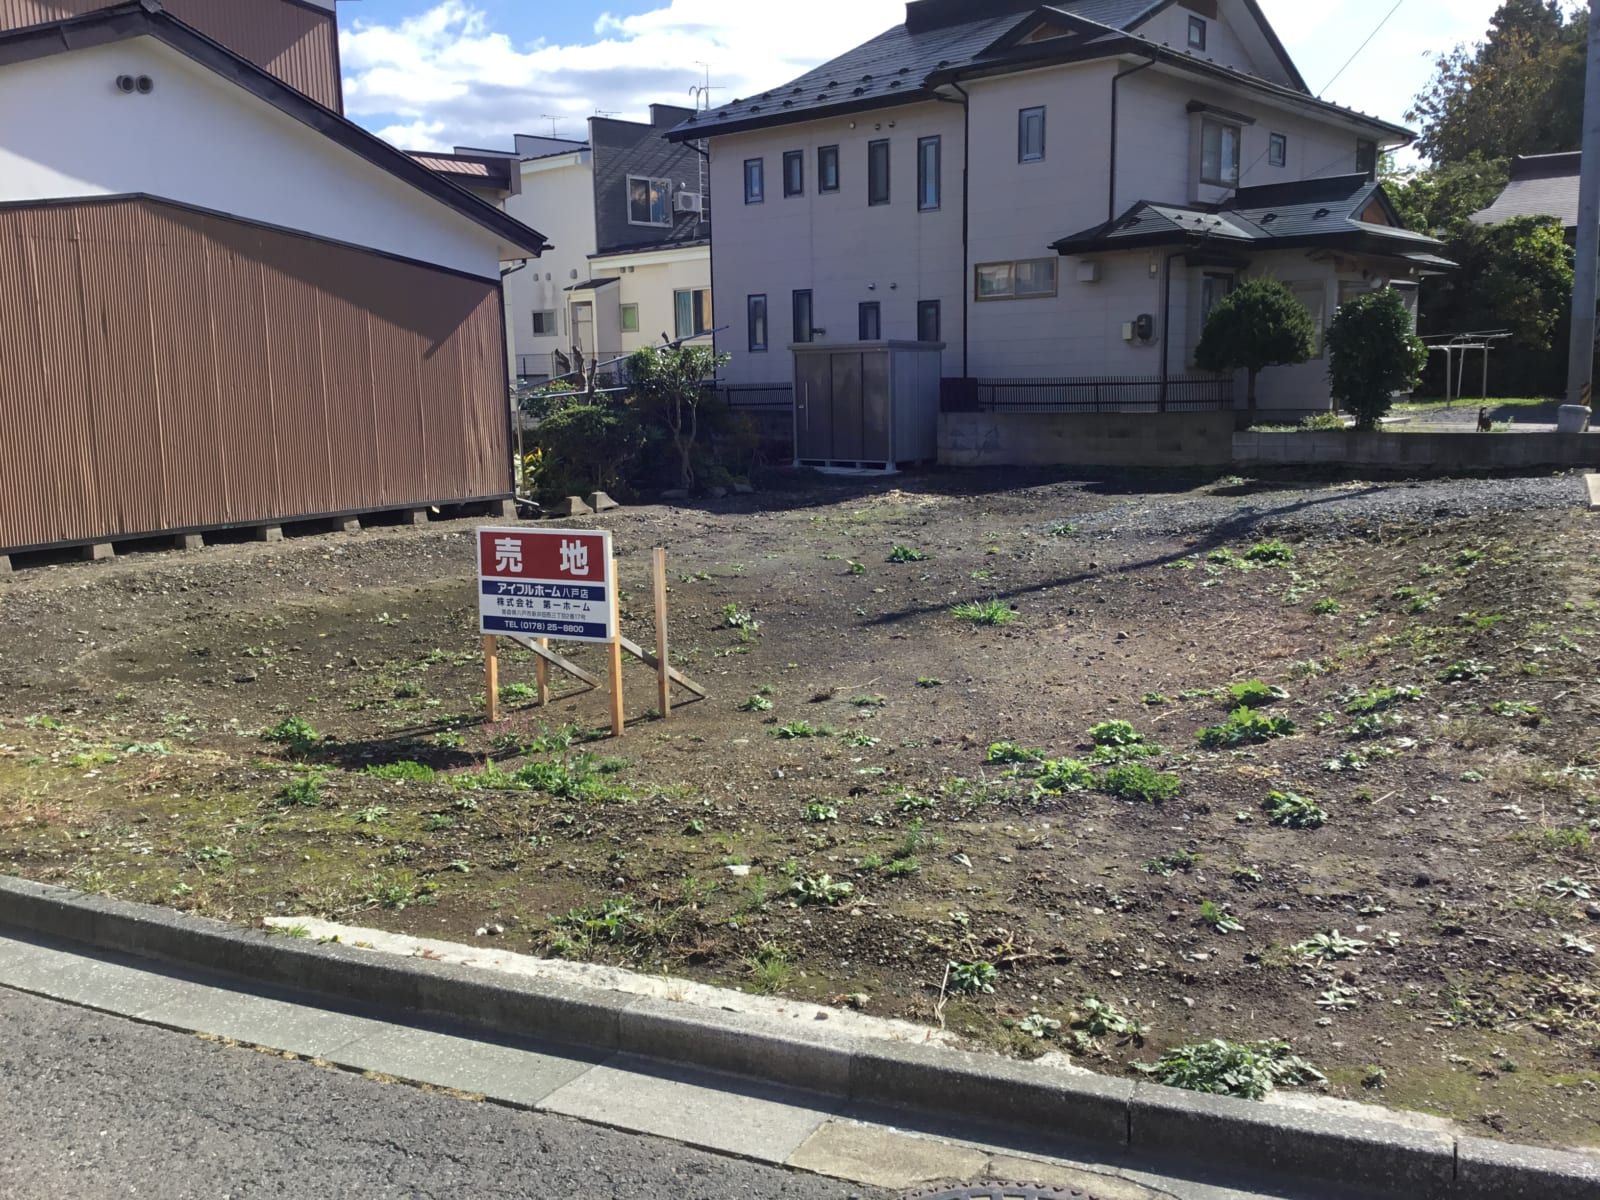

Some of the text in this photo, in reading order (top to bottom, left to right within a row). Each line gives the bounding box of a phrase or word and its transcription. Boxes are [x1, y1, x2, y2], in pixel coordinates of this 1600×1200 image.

[497, 597, 590, 611] 株式会社 第一ホーム
[504, 620, 519, 629] TEL
